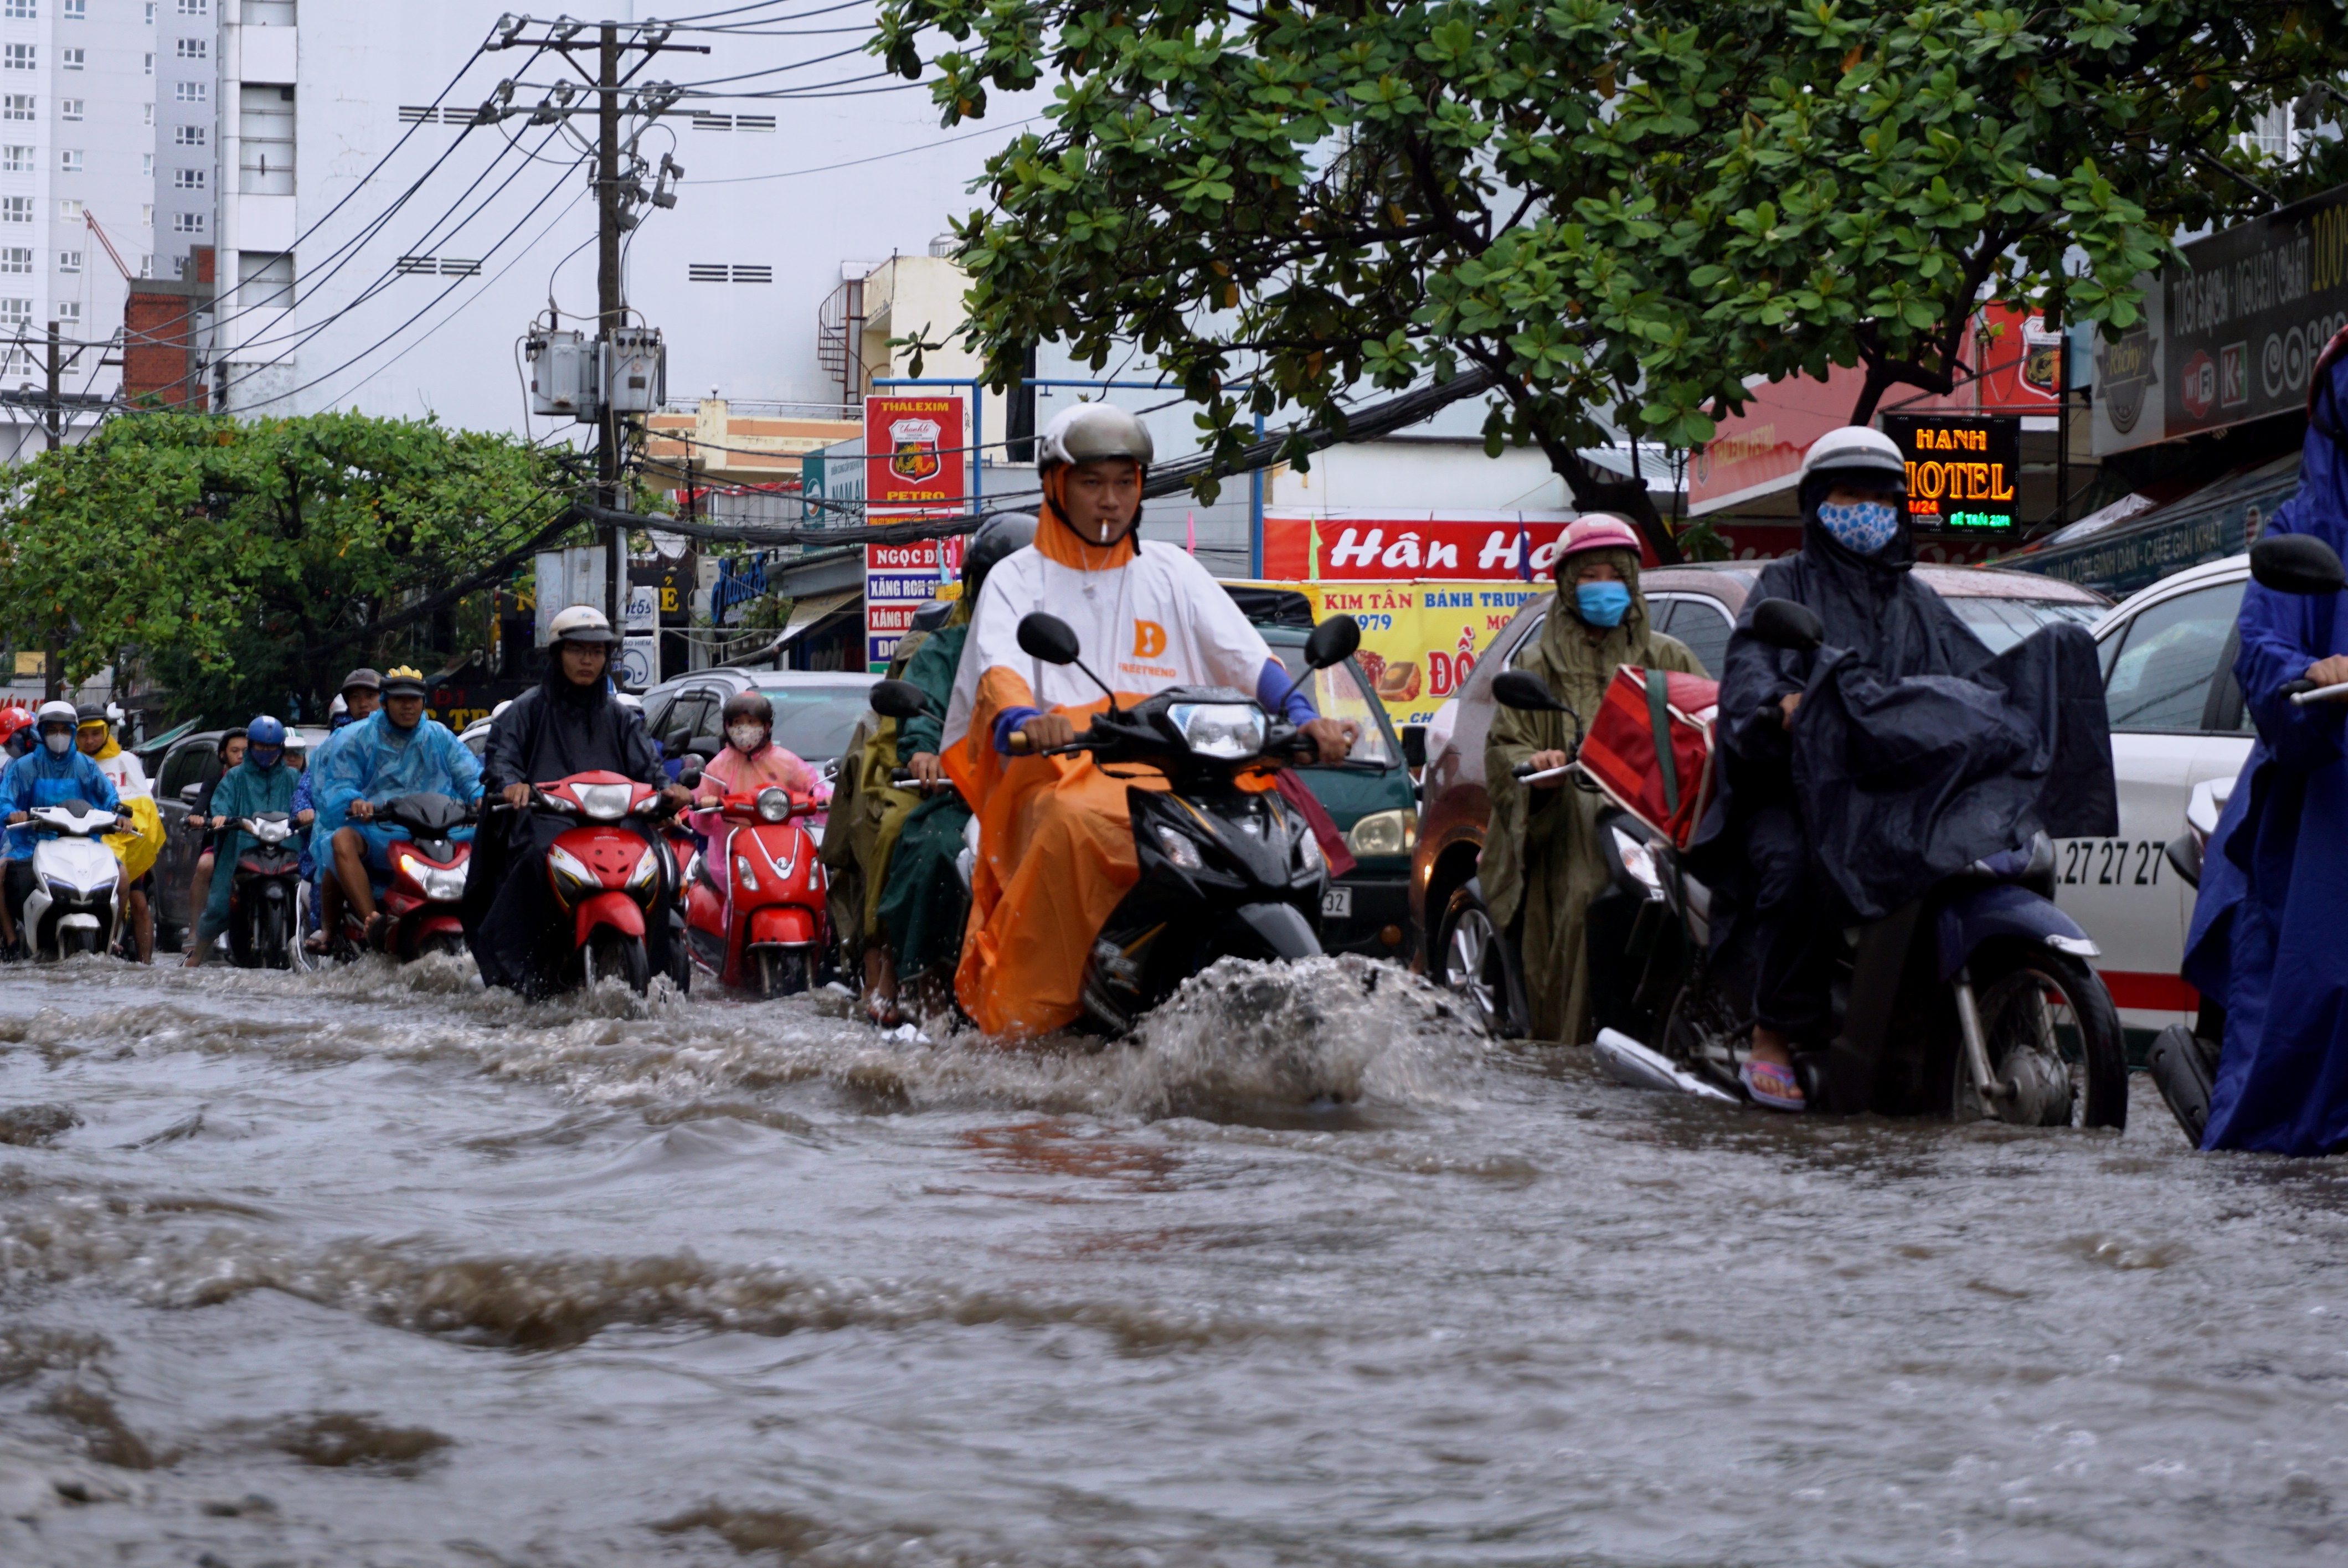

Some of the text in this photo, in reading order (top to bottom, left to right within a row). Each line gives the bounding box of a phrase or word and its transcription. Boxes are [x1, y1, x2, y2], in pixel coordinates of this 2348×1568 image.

[2109, 341, 2141, 377] Richy
[881, 402, 949, 411] THALEXIM
[887, 491, 945, 501] PETRO
[876, 549, 921, 567] NGỌC
[1330, 528, 1458, 569] Hân
[871, 577, 901, 597] XĂNG
[1324, 594, 1363, 610] KIM
[1368, 589, 1413, 609] TÂN
[1424, 589, 1473, 608] BÁNH
[872, 608, 902, 628] XĂNG
[2099, 840, 2129, 885] 27
[2134, 840, 2165, 885] 27
